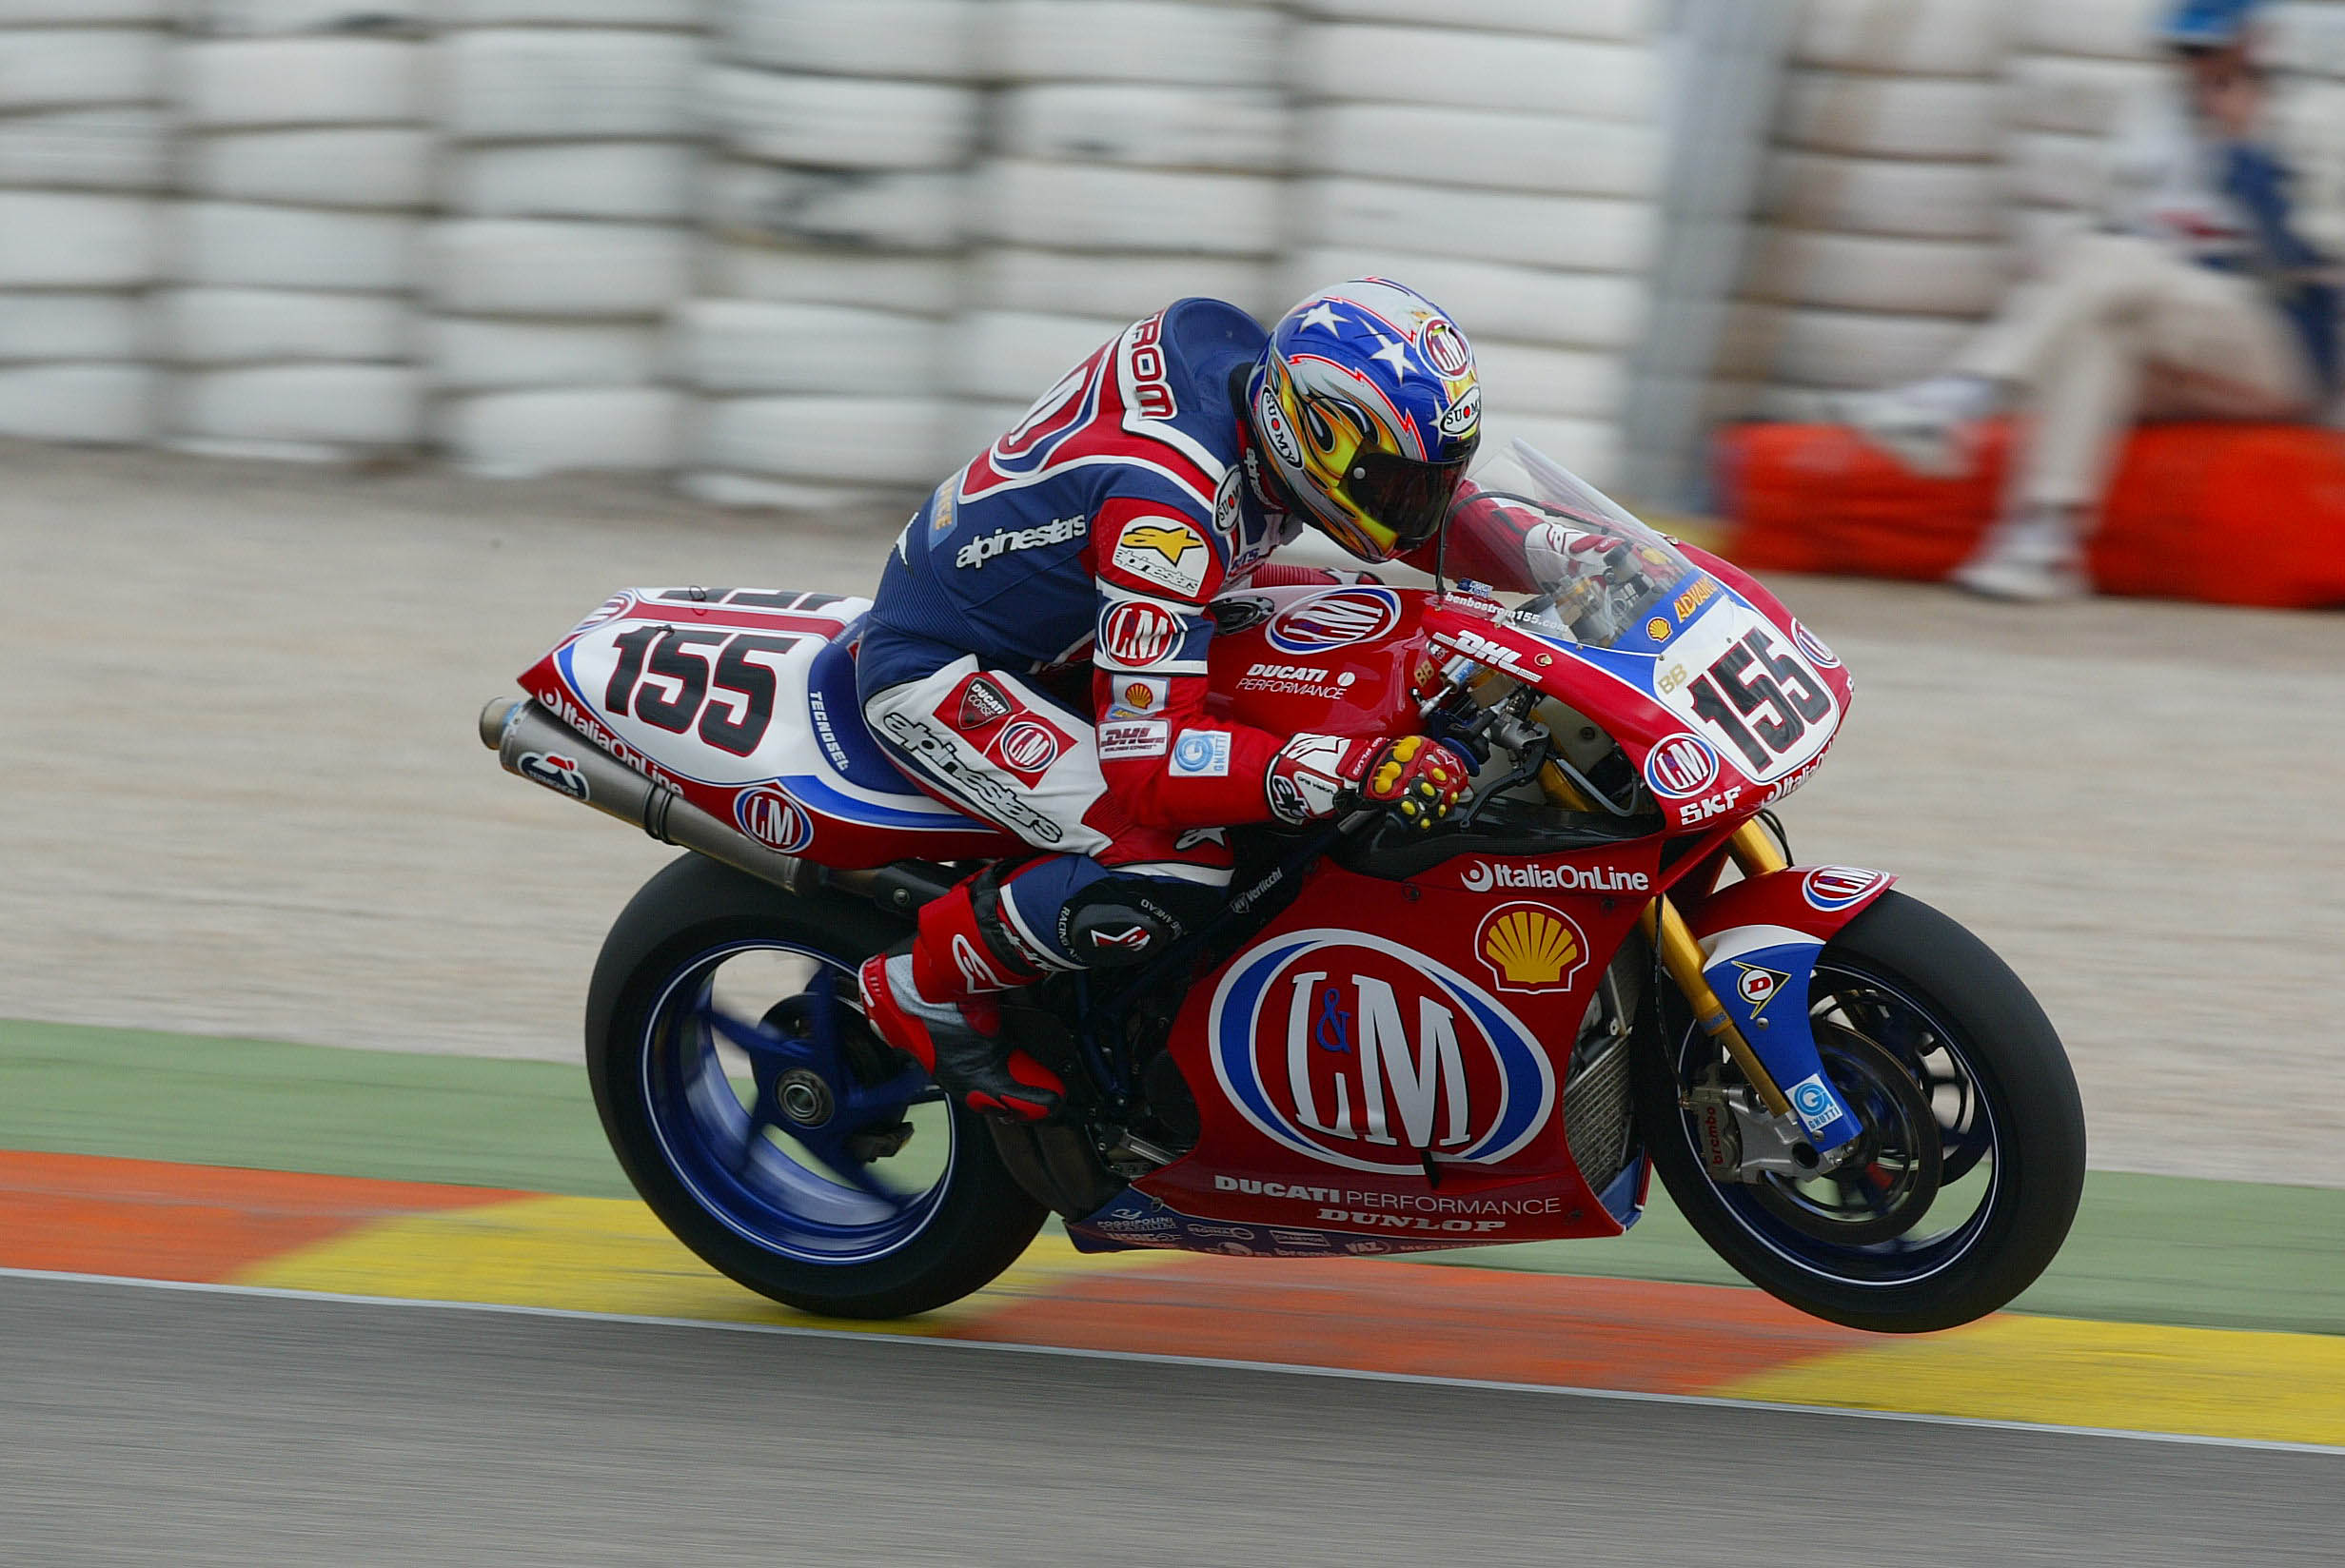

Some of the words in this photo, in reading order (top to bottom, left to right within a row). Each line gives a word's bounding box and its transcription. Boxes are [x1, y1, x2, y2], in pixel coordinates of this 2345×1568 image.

[1132, 308, 1173, 418] ROM
[1266, 392, 1296, 464] SUOMY
[1446, 399, 1480, 425] SUOM
[956, 514, 1087, 569] alpinestars
[1445, 591, 1569, 633] benbostrom155.com
[605, 625, 802, 757] 155
[1235, 677, 1347, 700] PERFORMANCE
[1246, 663, 1330, 682] DUCATI
[971, 683, 1007, 715] DUCATI
[1686, 625, 1832, 774] 155
[563, 705, 684, 797] ItaliaOnLine
[1102, 727, 1164, 748] DHL
[883, 712, 1063, 844] alpinestars
[1679, 786, 1742, 826] SKF
[1494, 863, 1650, 892] ItaliaOnLine
[1748, 976, 1771, 994] D
[1287, 970, 1471, 1149] L&M
[1214, 1175, 1341, 1205] DUCATI
[1348, 1190, 1561, 1217] PERFORMANCE
[1317, 1208, 1507, 1232] DUNLOP
